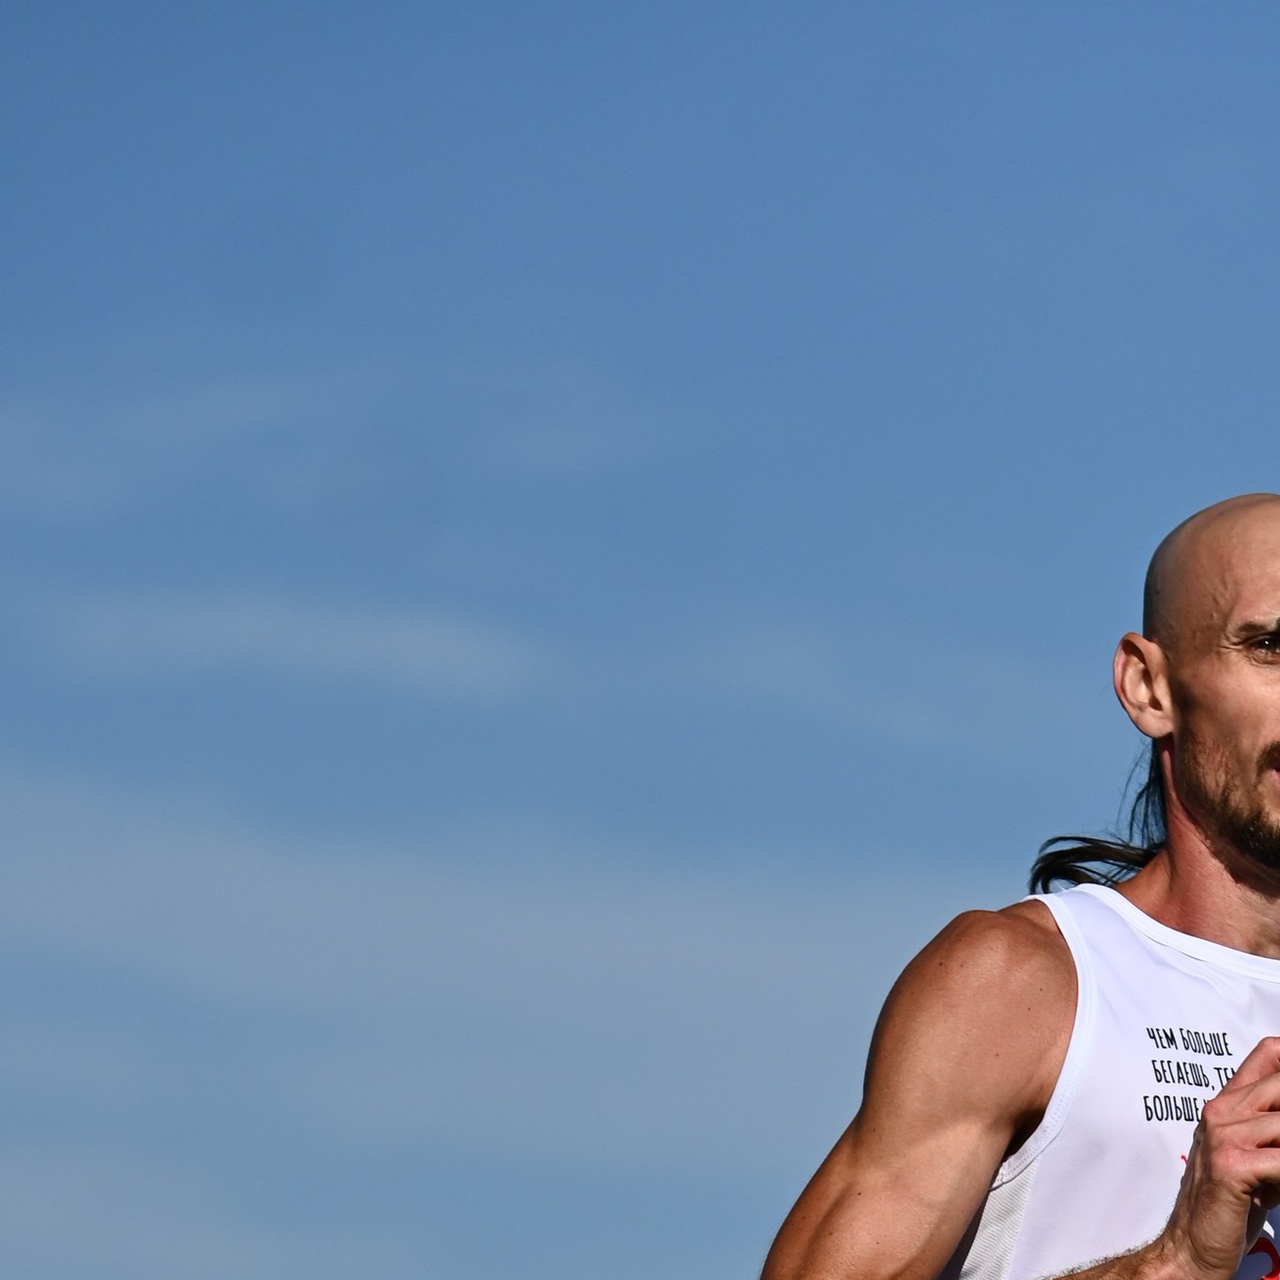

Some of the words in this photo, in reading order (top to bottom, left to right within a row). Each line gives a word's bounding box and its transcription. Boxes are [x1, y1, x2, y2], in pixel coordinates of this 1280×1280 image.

[1146, 1027, 1178, 1050] ЧЕМ
[1179, 1028, 1233, 1056] БОЛЬШЕ
[1151, 1060, 1215, 1091] БЕГАЕШЬ,
[1213, 1067, 1236, 1088] ТЕ
[1143, 1095, 1201, 1122] БОЛЬШЕ
